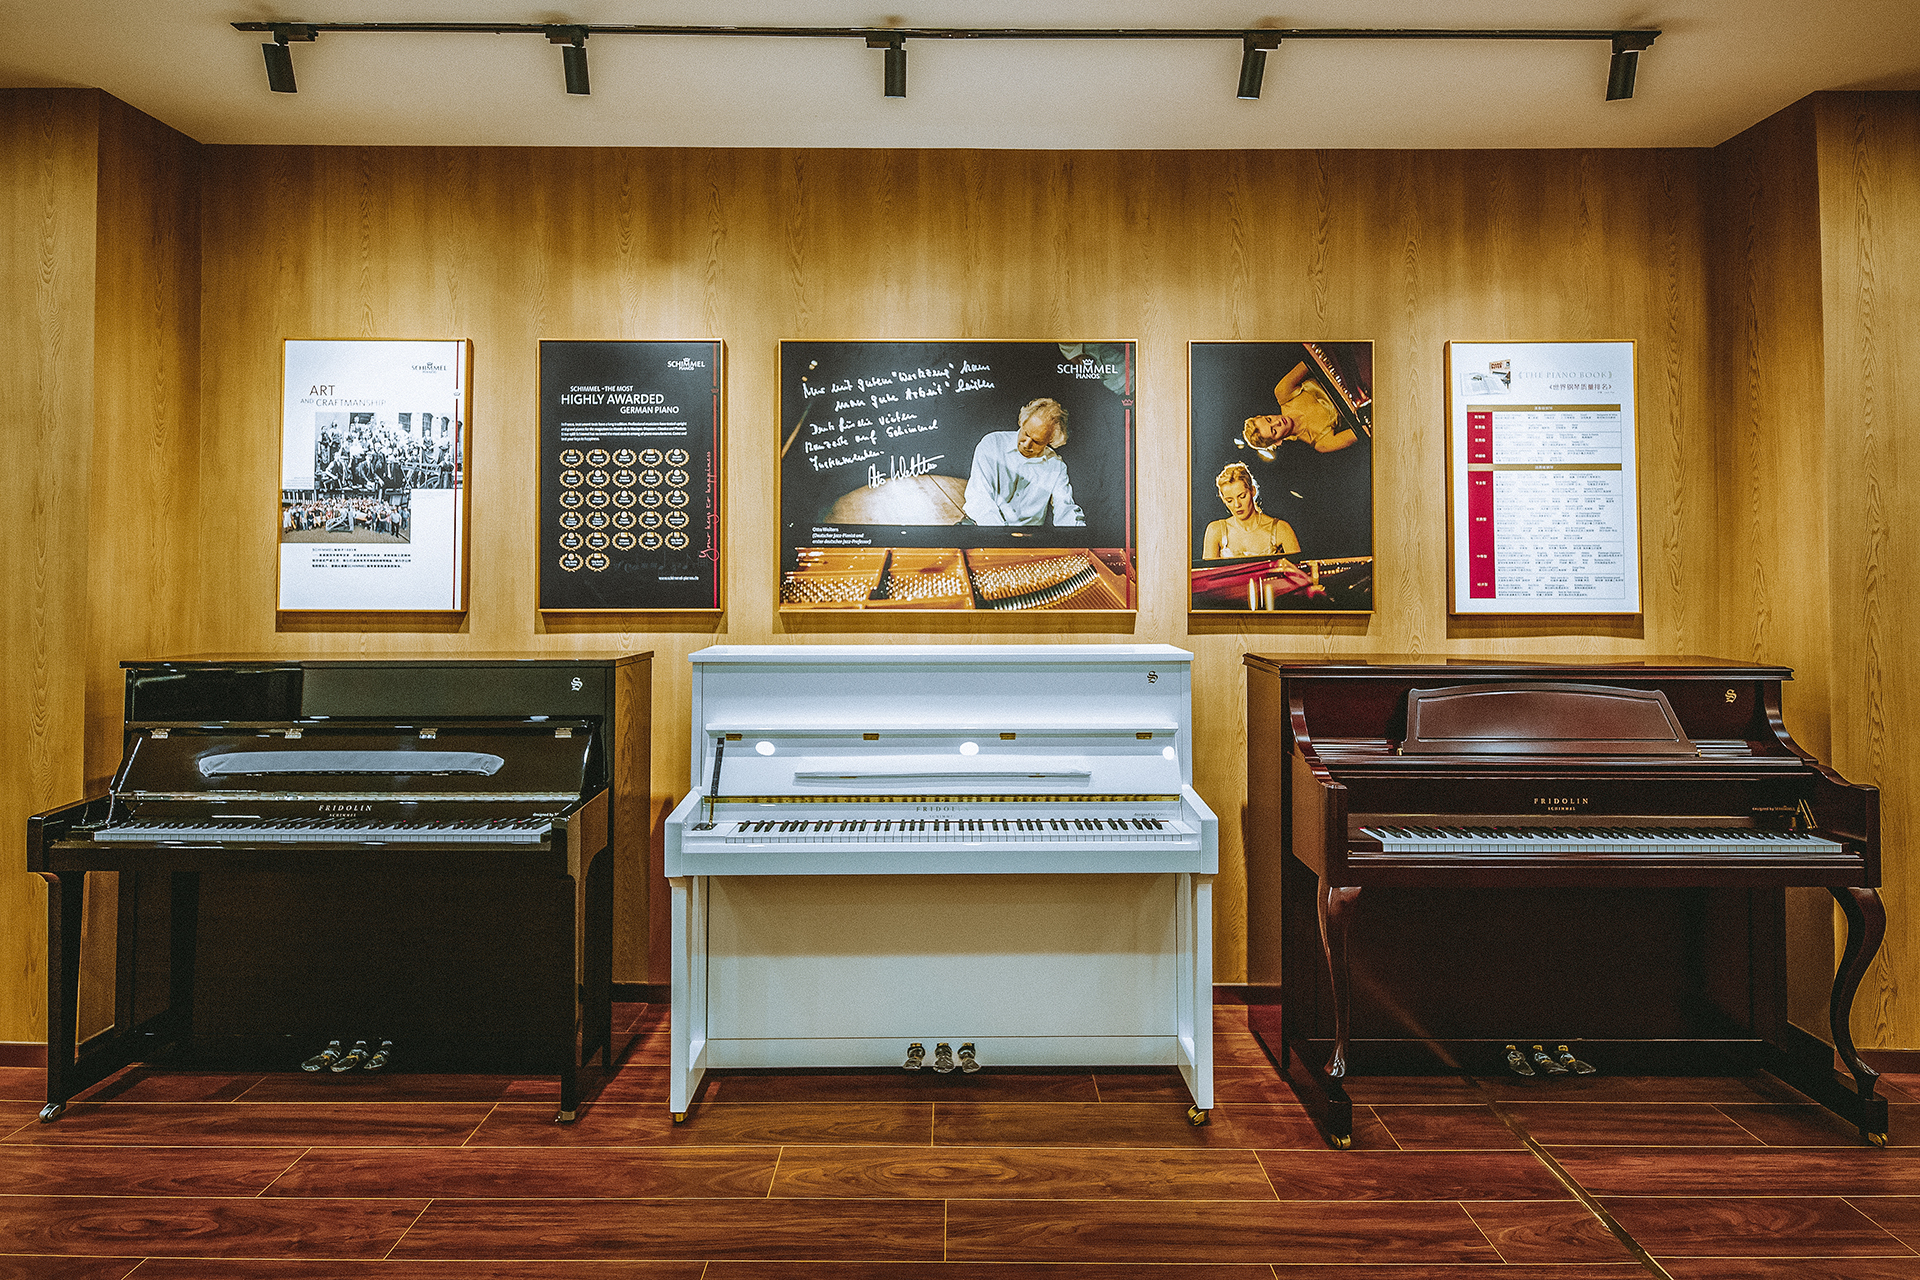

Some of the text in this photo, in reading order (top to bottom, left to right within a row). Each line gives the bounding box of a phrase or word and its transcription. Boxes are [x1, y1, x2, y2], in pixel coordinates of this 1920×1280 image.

[667, 360, 706, 368] SCHIMMEL
[1056, 364, 1119, 374] SCHIMMEL
[1546, 371, 1577, 379] PIANO
[309, 384, 336, 396] ART
[561, 393, 665, 405] HIGHLY AWARDED
[620, 405, 680, 414] GERMAN PIANO
[318, 804, 373, 812] FRIDOLIN
